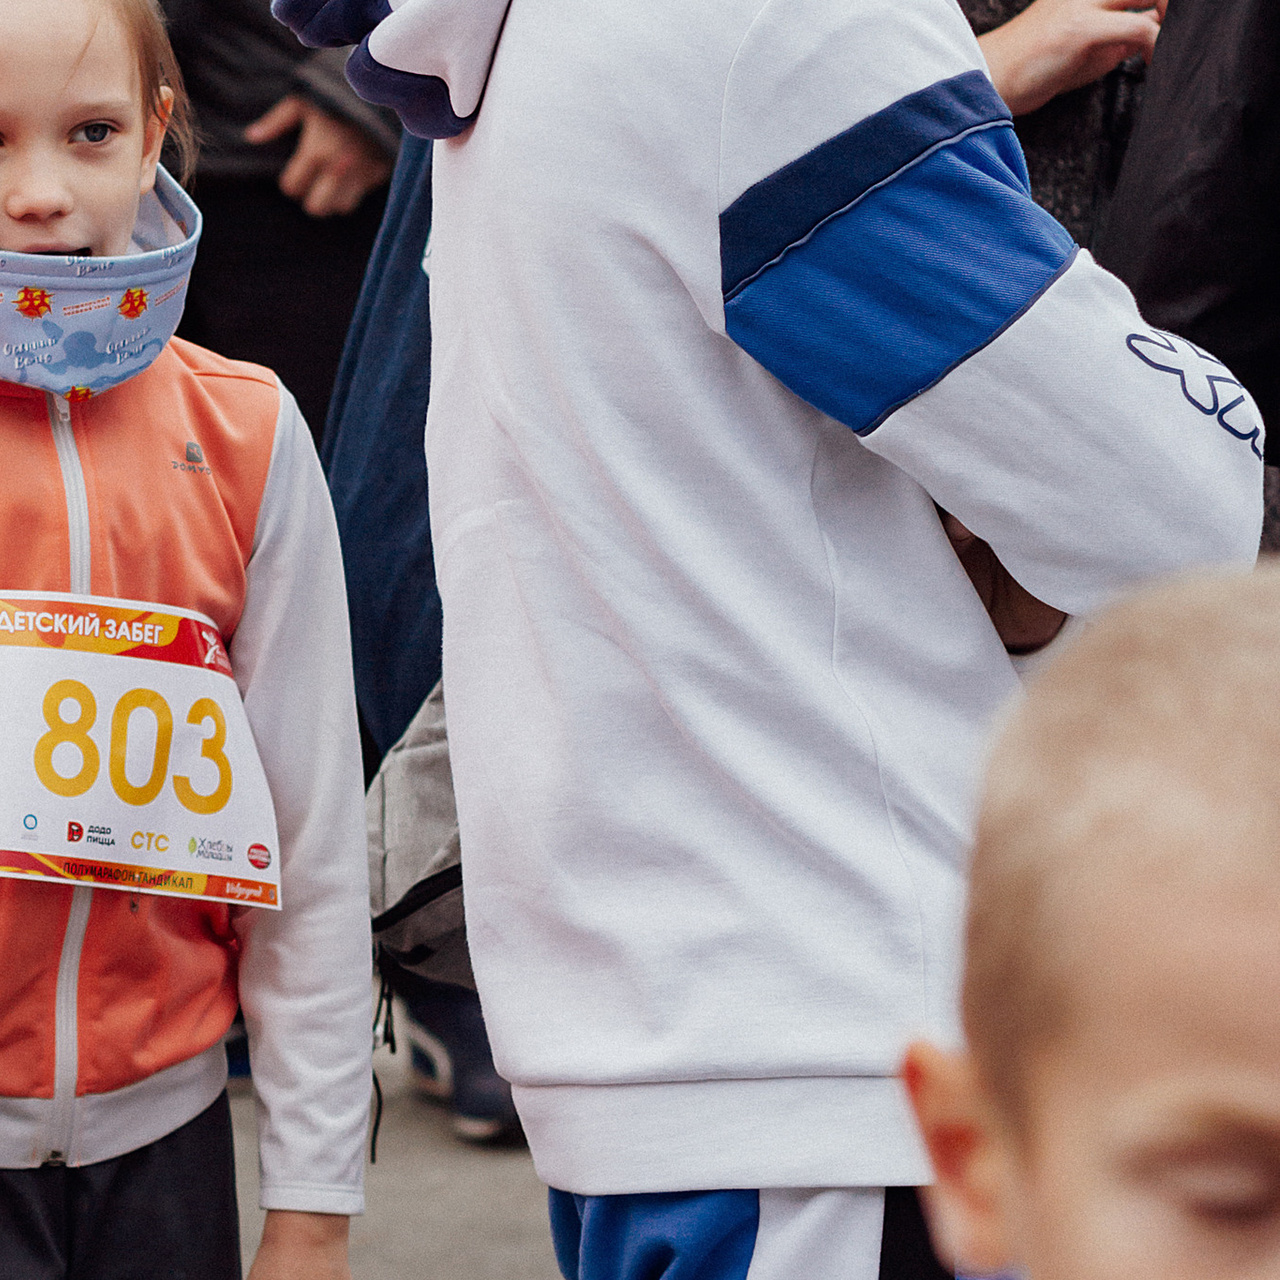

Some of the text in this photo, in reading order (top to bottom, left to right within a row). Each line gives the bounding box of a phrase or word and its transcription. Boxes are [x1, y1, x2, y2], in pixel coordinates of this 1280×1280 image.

[105, 622, 164, 645] ЗАБЕГ
[33, 679, 233, 815] 803
[130, 831, 170, 852] СТС
[63, 862, 194, 889] ПОЛУМАРАФОН ГАНДИКАП
